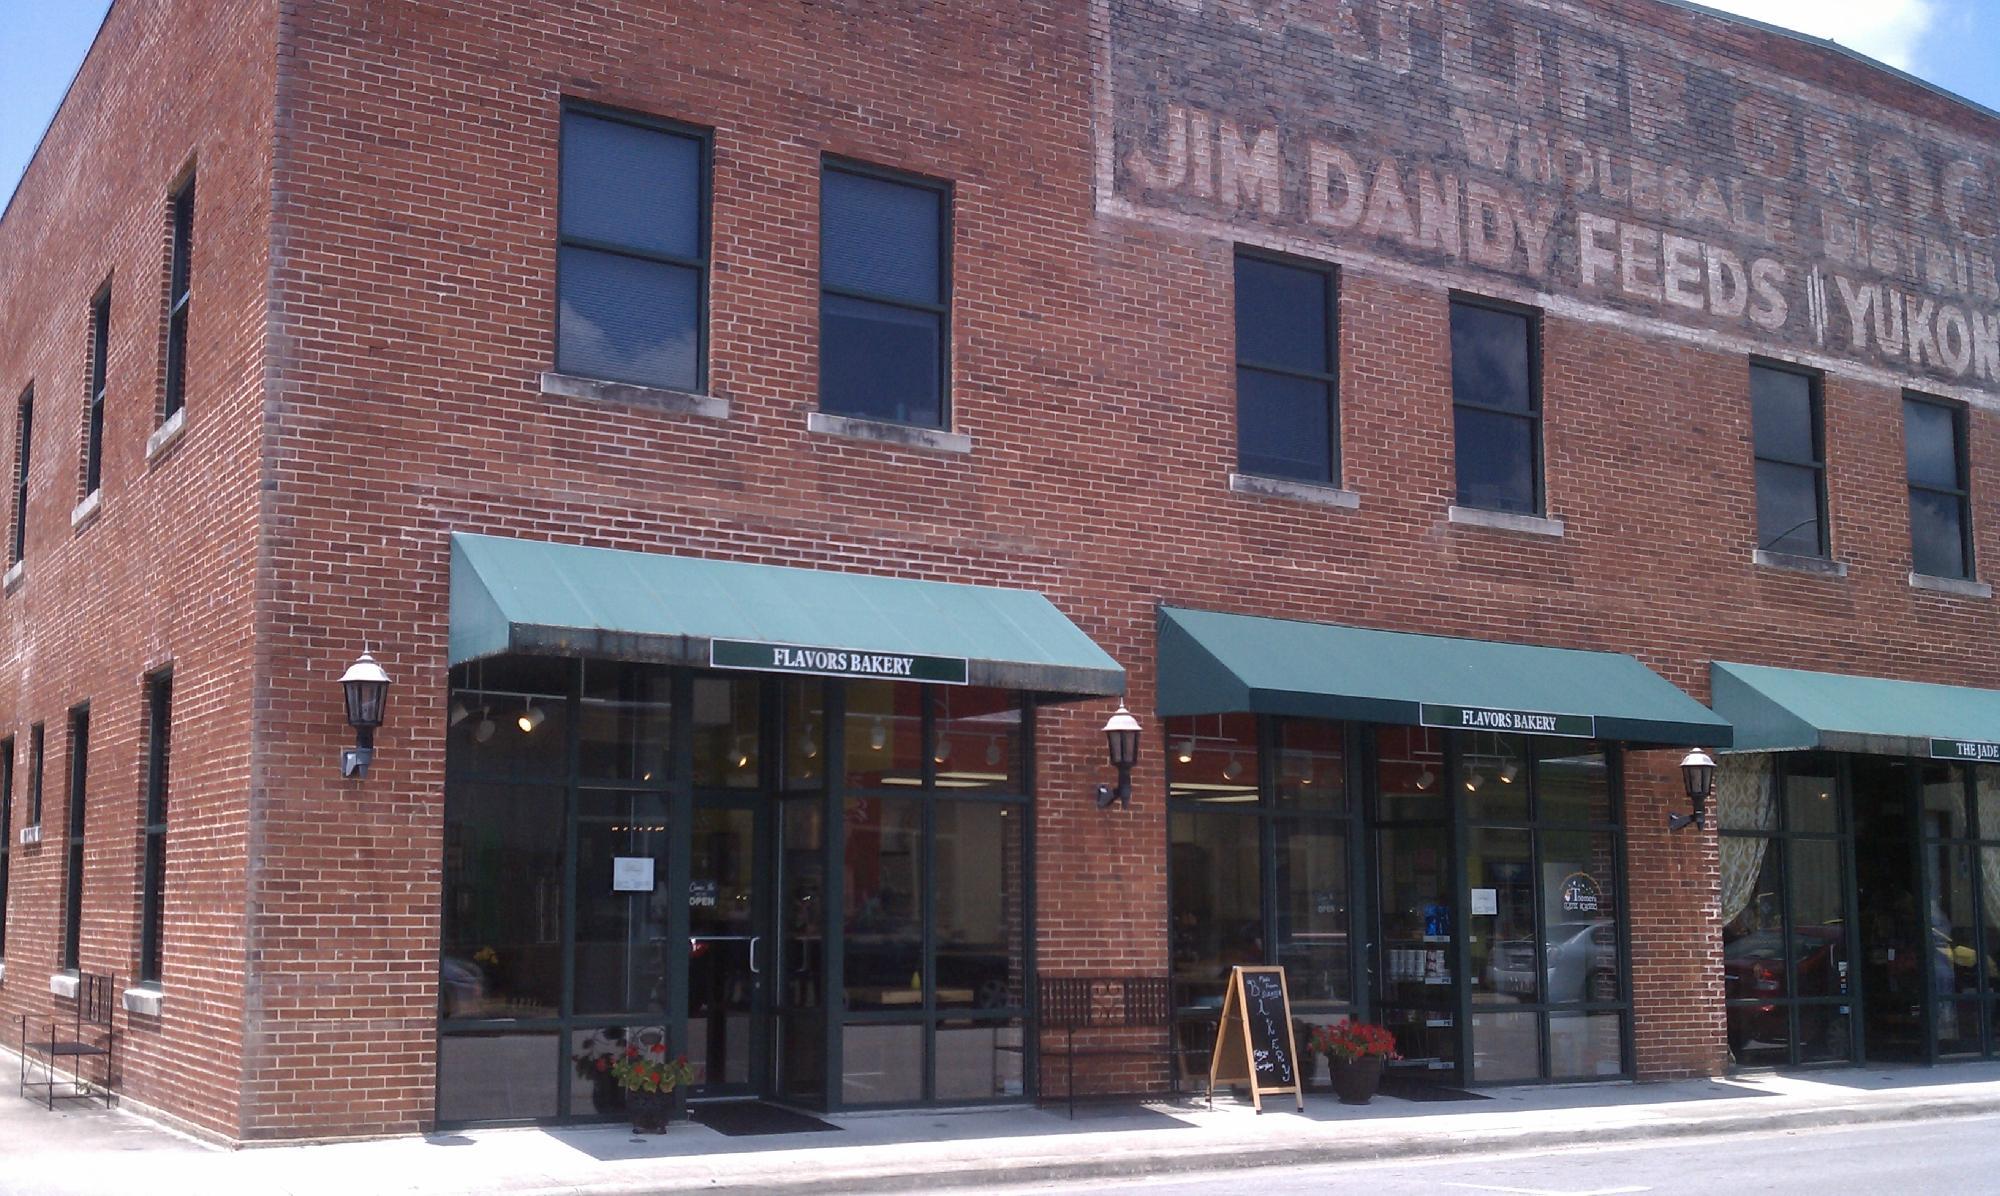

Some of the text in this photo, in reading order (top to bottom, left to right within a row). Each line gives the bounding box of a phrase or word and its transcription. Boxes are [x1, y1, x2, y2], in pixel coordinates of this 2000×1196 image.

[1123, 102, 2000, 385] JIM DANDY FEEDS YUKON
[773, 648, 914, 675] FLAVORS BAKERY
[1462, 710, 1556, 731] FLAVORS BAKERY
[1956, 743, 1999, 759] THE JADE
[689, 896, 714, 906] OPEN
